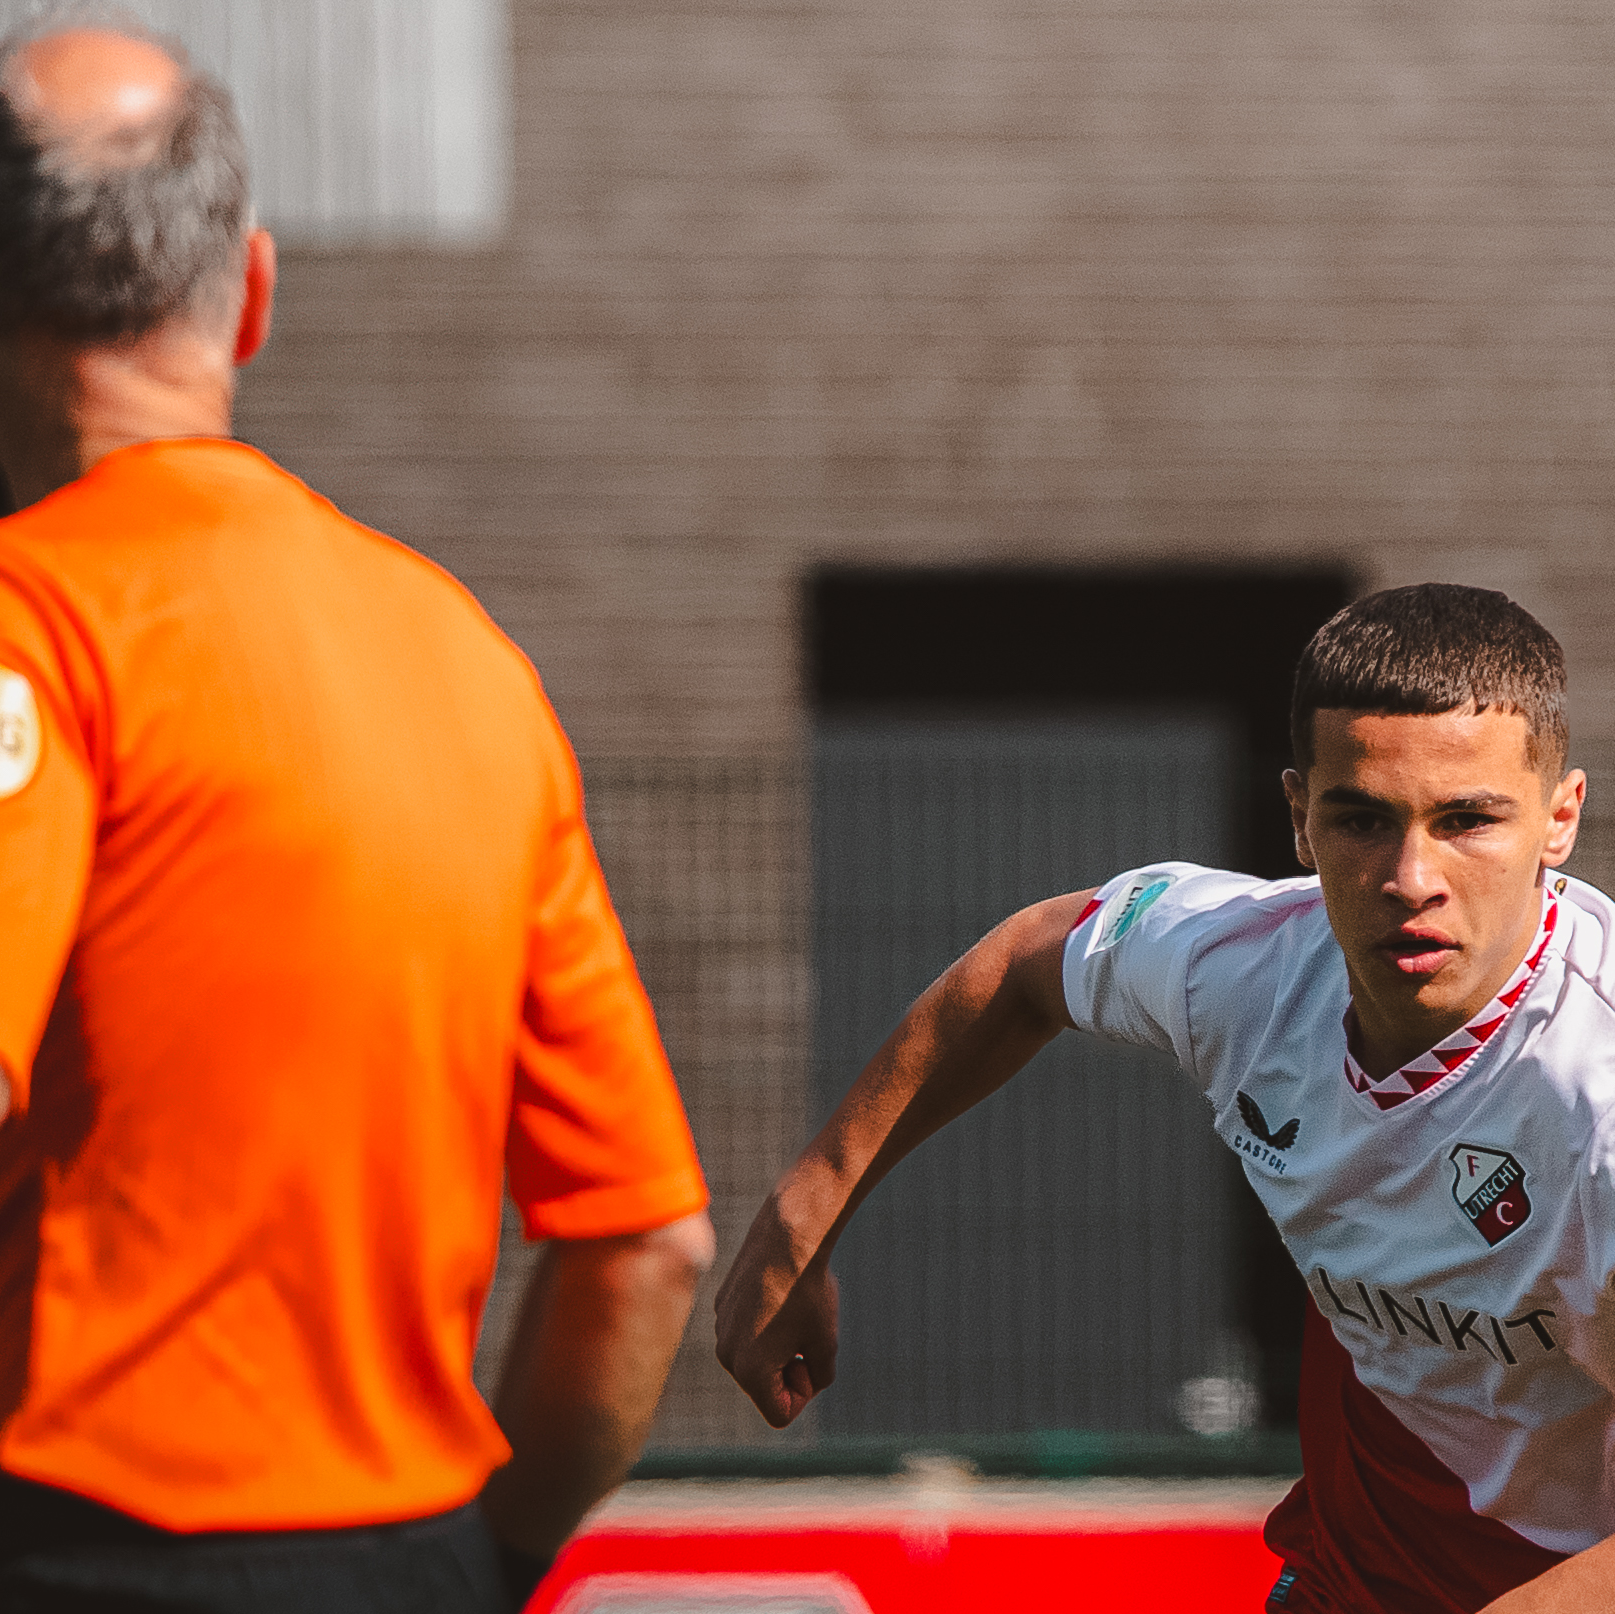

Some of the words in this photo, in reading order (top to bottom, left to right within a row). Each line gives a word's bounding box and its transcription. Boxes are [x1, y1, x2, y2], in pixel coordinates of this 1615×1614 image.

[1234, 1135, 1287, 1175] CASTORE
[1466, 1154, 1480, 1177] F
[1465, 1160, 1520, 1220] UTRECHT
[1496, 1201, 1514, 1226] C
[1317, 1266, 1557, 1366] LINKIT
